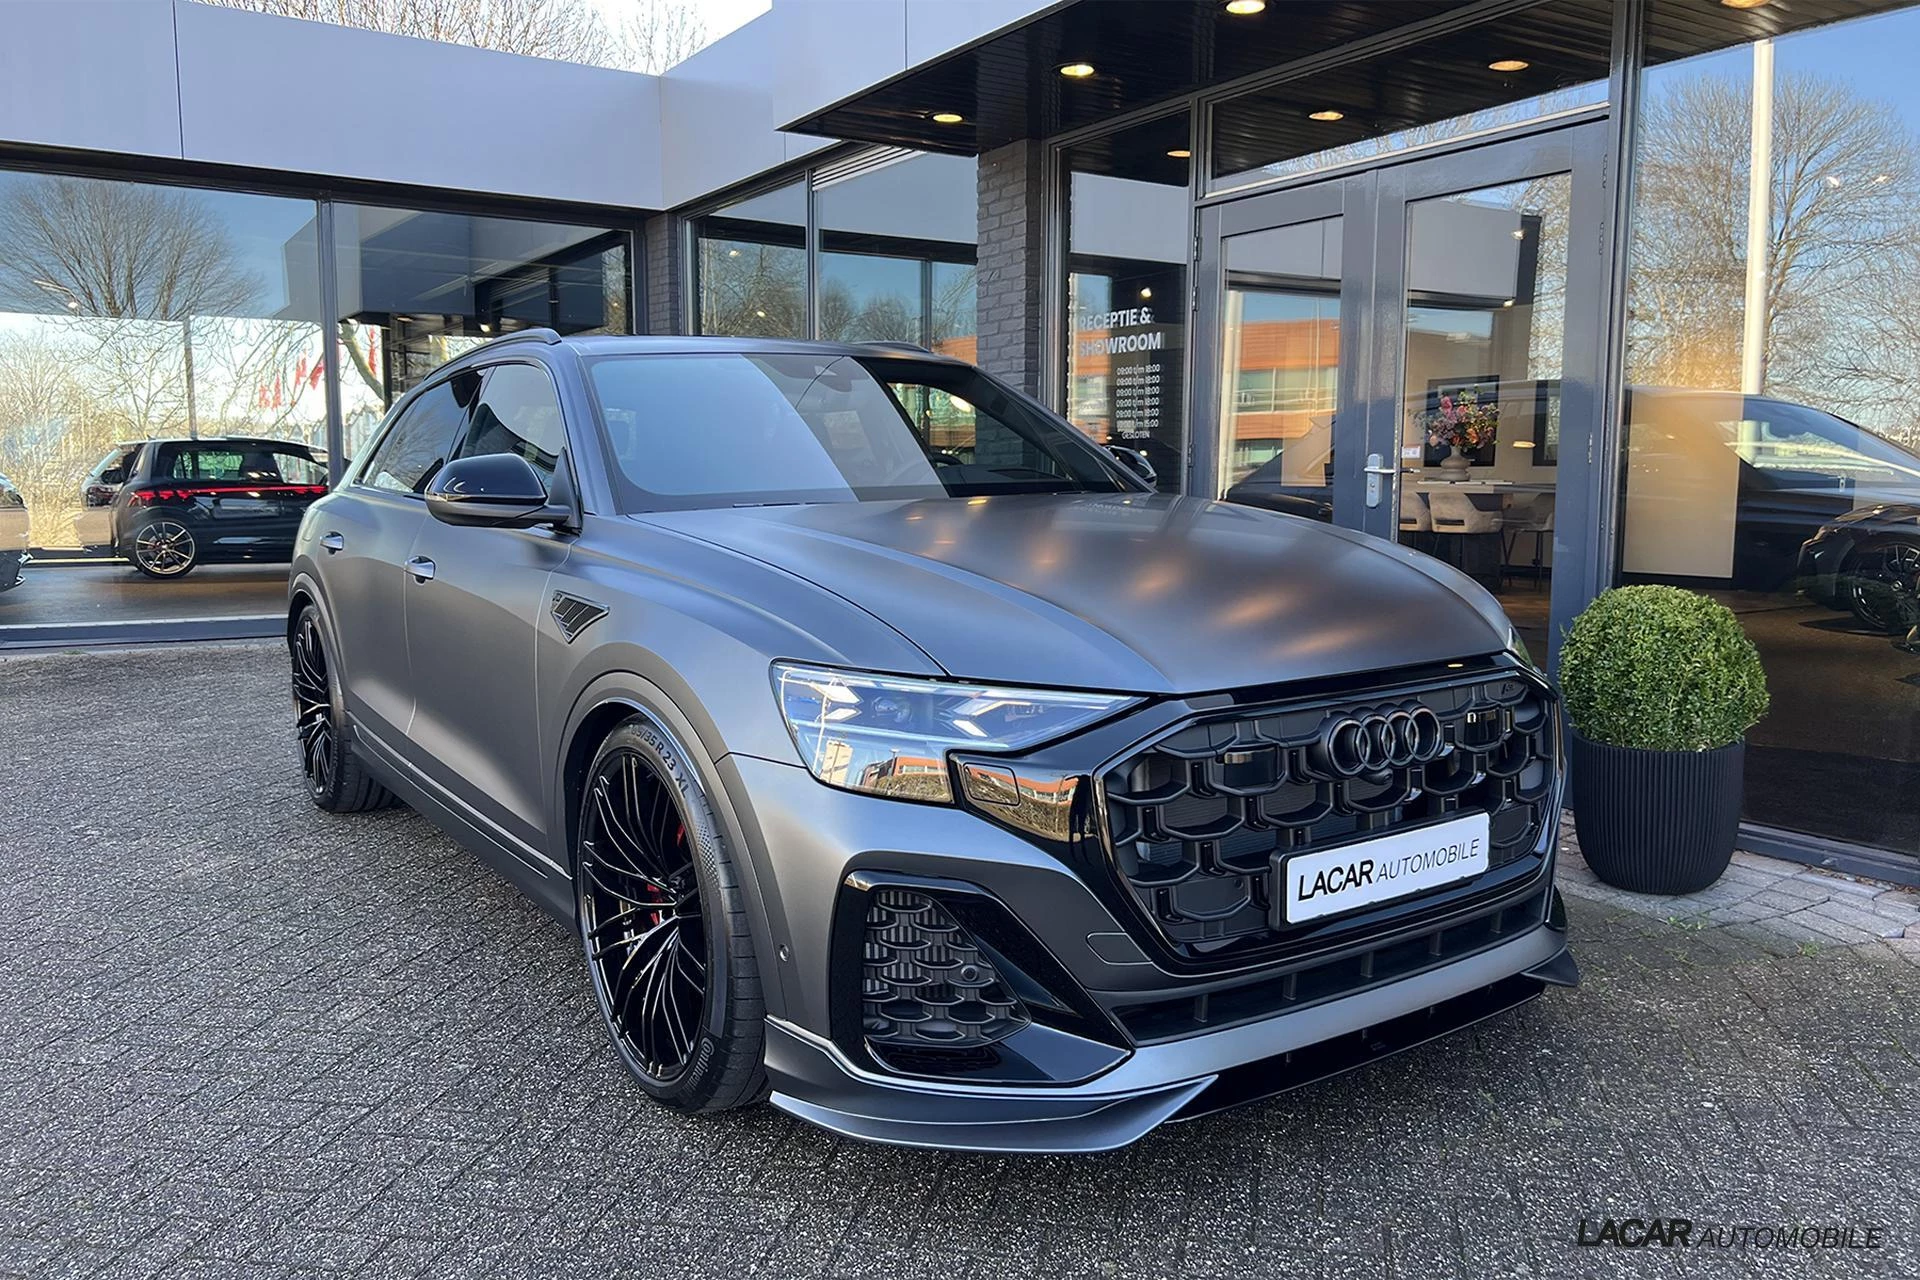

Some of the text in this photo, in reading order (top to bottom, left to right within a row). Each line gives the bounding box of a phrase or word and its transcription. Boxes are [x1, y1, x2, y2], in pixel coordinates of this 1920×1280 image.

[1079, 306, 1152, 331] RECEPTIE &
[1079, 332, 1161, 357] SHOWROOM
[1133, 364, 1144, 375] t/m
[1145, 364, 1160, 373] 18:00
[1133, 375, 1144, 386] t/m
[1145, 375, 1160, 384] 18:00
[1132, 386, 1144, 396] t/m
[1145, 386, 1159, 395] 18:00
[1132, 397, 1143, 407] t/m
[1144, 397, 1159, 406] 18:00
[1132, 408, 1143, 418] t/m
[1144, 408, 1159, 417] 18:00
[675, 773, 689, 798] XL
[1298, 838, 1480, 901] LACAR AUTOMOBILE
